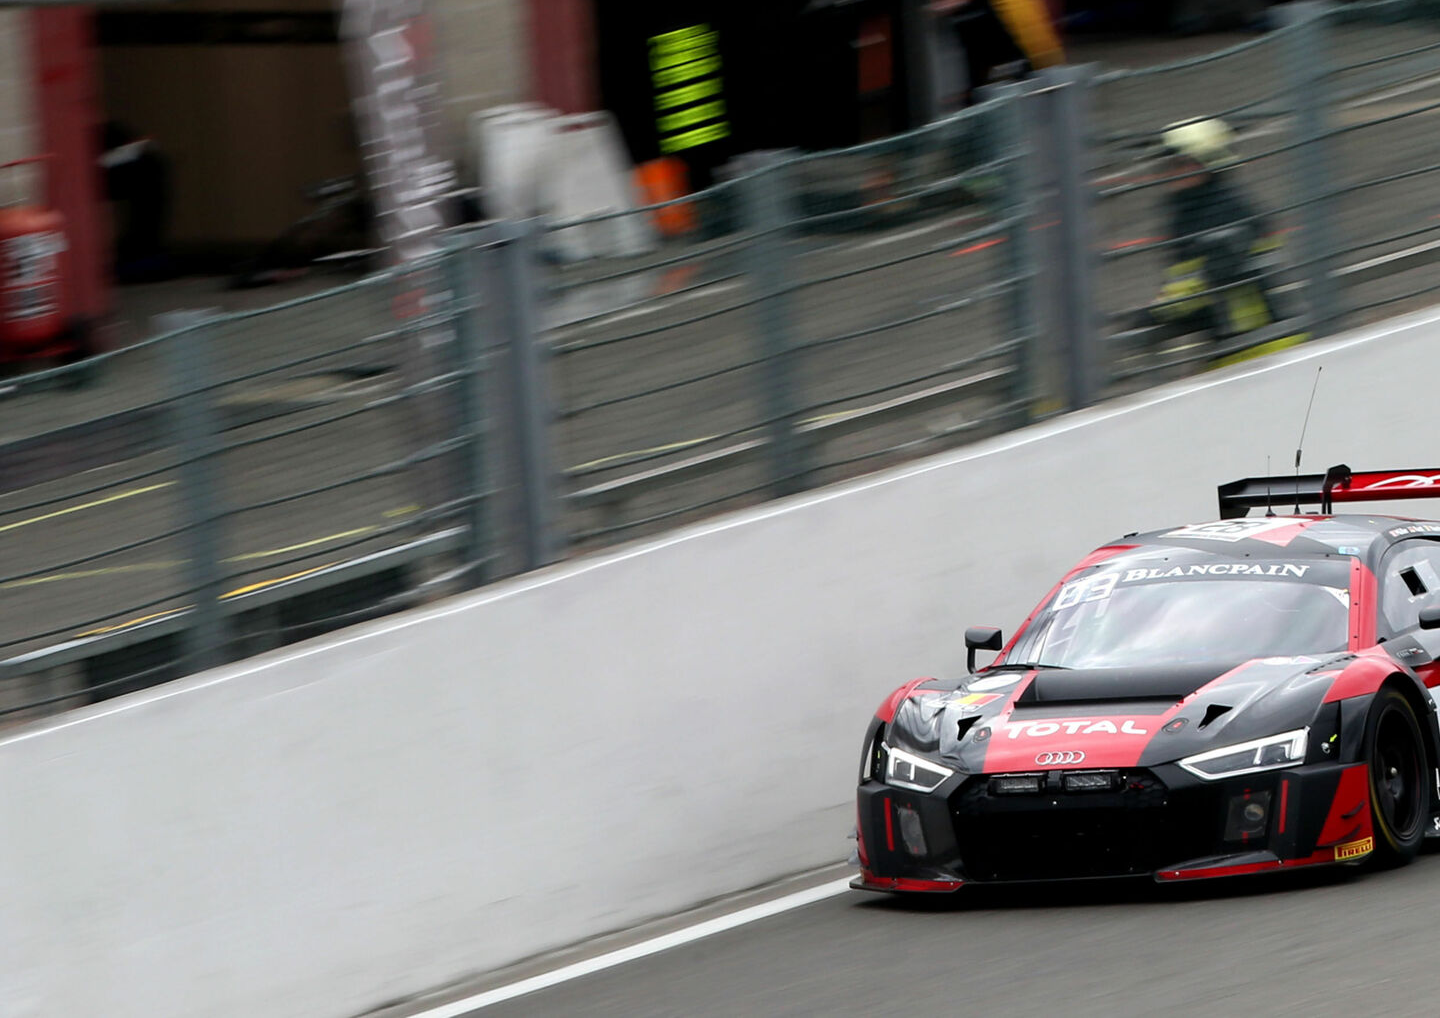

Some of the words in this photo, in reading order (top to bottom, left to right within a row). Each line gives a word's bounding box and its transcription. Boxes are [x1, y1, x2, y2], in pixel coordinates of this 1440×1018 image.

[1122, 564, 1310, 582] BLANCPAIN
[1004, 720, 1147, 739] TOTAL
[1337, 839, 1371, 858] PIRELLI
